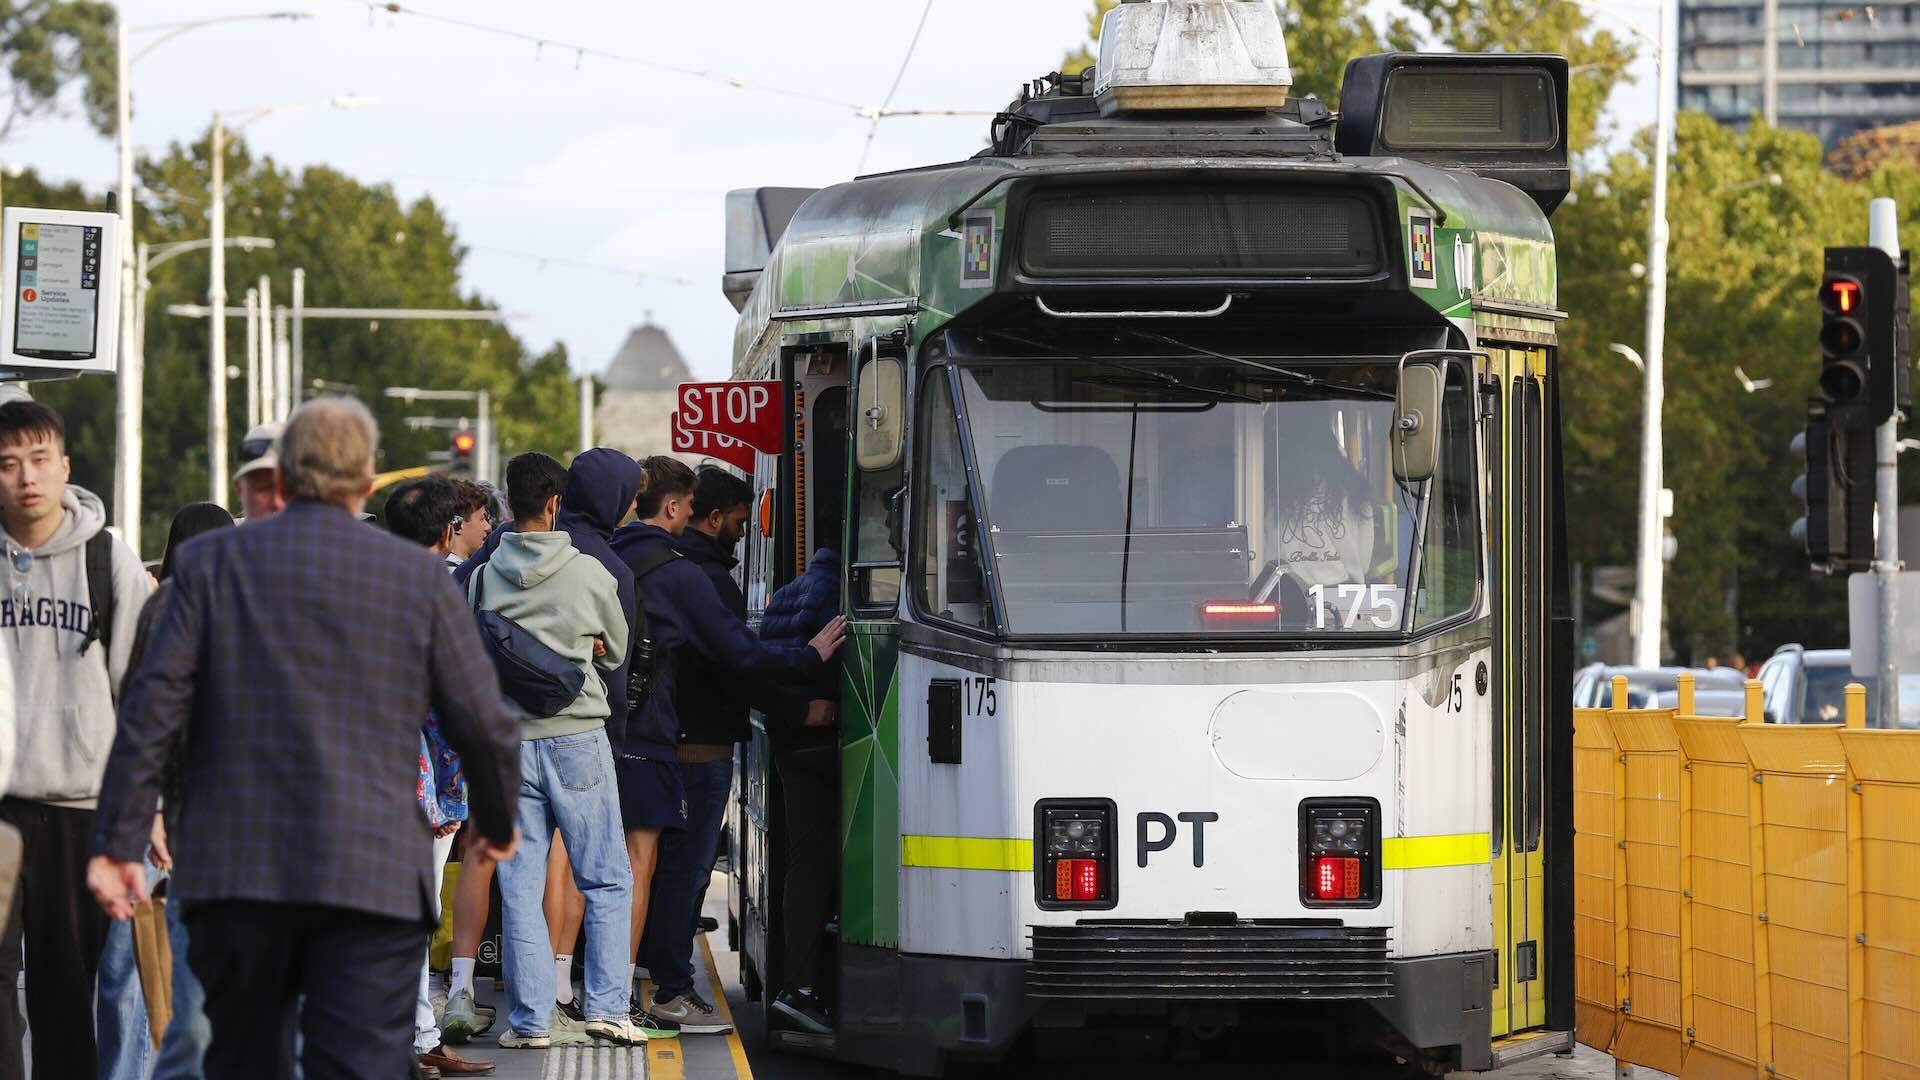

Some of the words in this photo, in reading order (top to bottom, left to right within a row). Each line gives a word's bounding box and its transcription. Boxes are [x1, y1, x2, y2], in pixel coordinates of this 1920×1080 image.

[683, 386, 769, 425] STOP
[1308, 583, 1398, 629] 175
[964, 676, 996, 717] 175
[1136, 811, 1219, 869] PT
